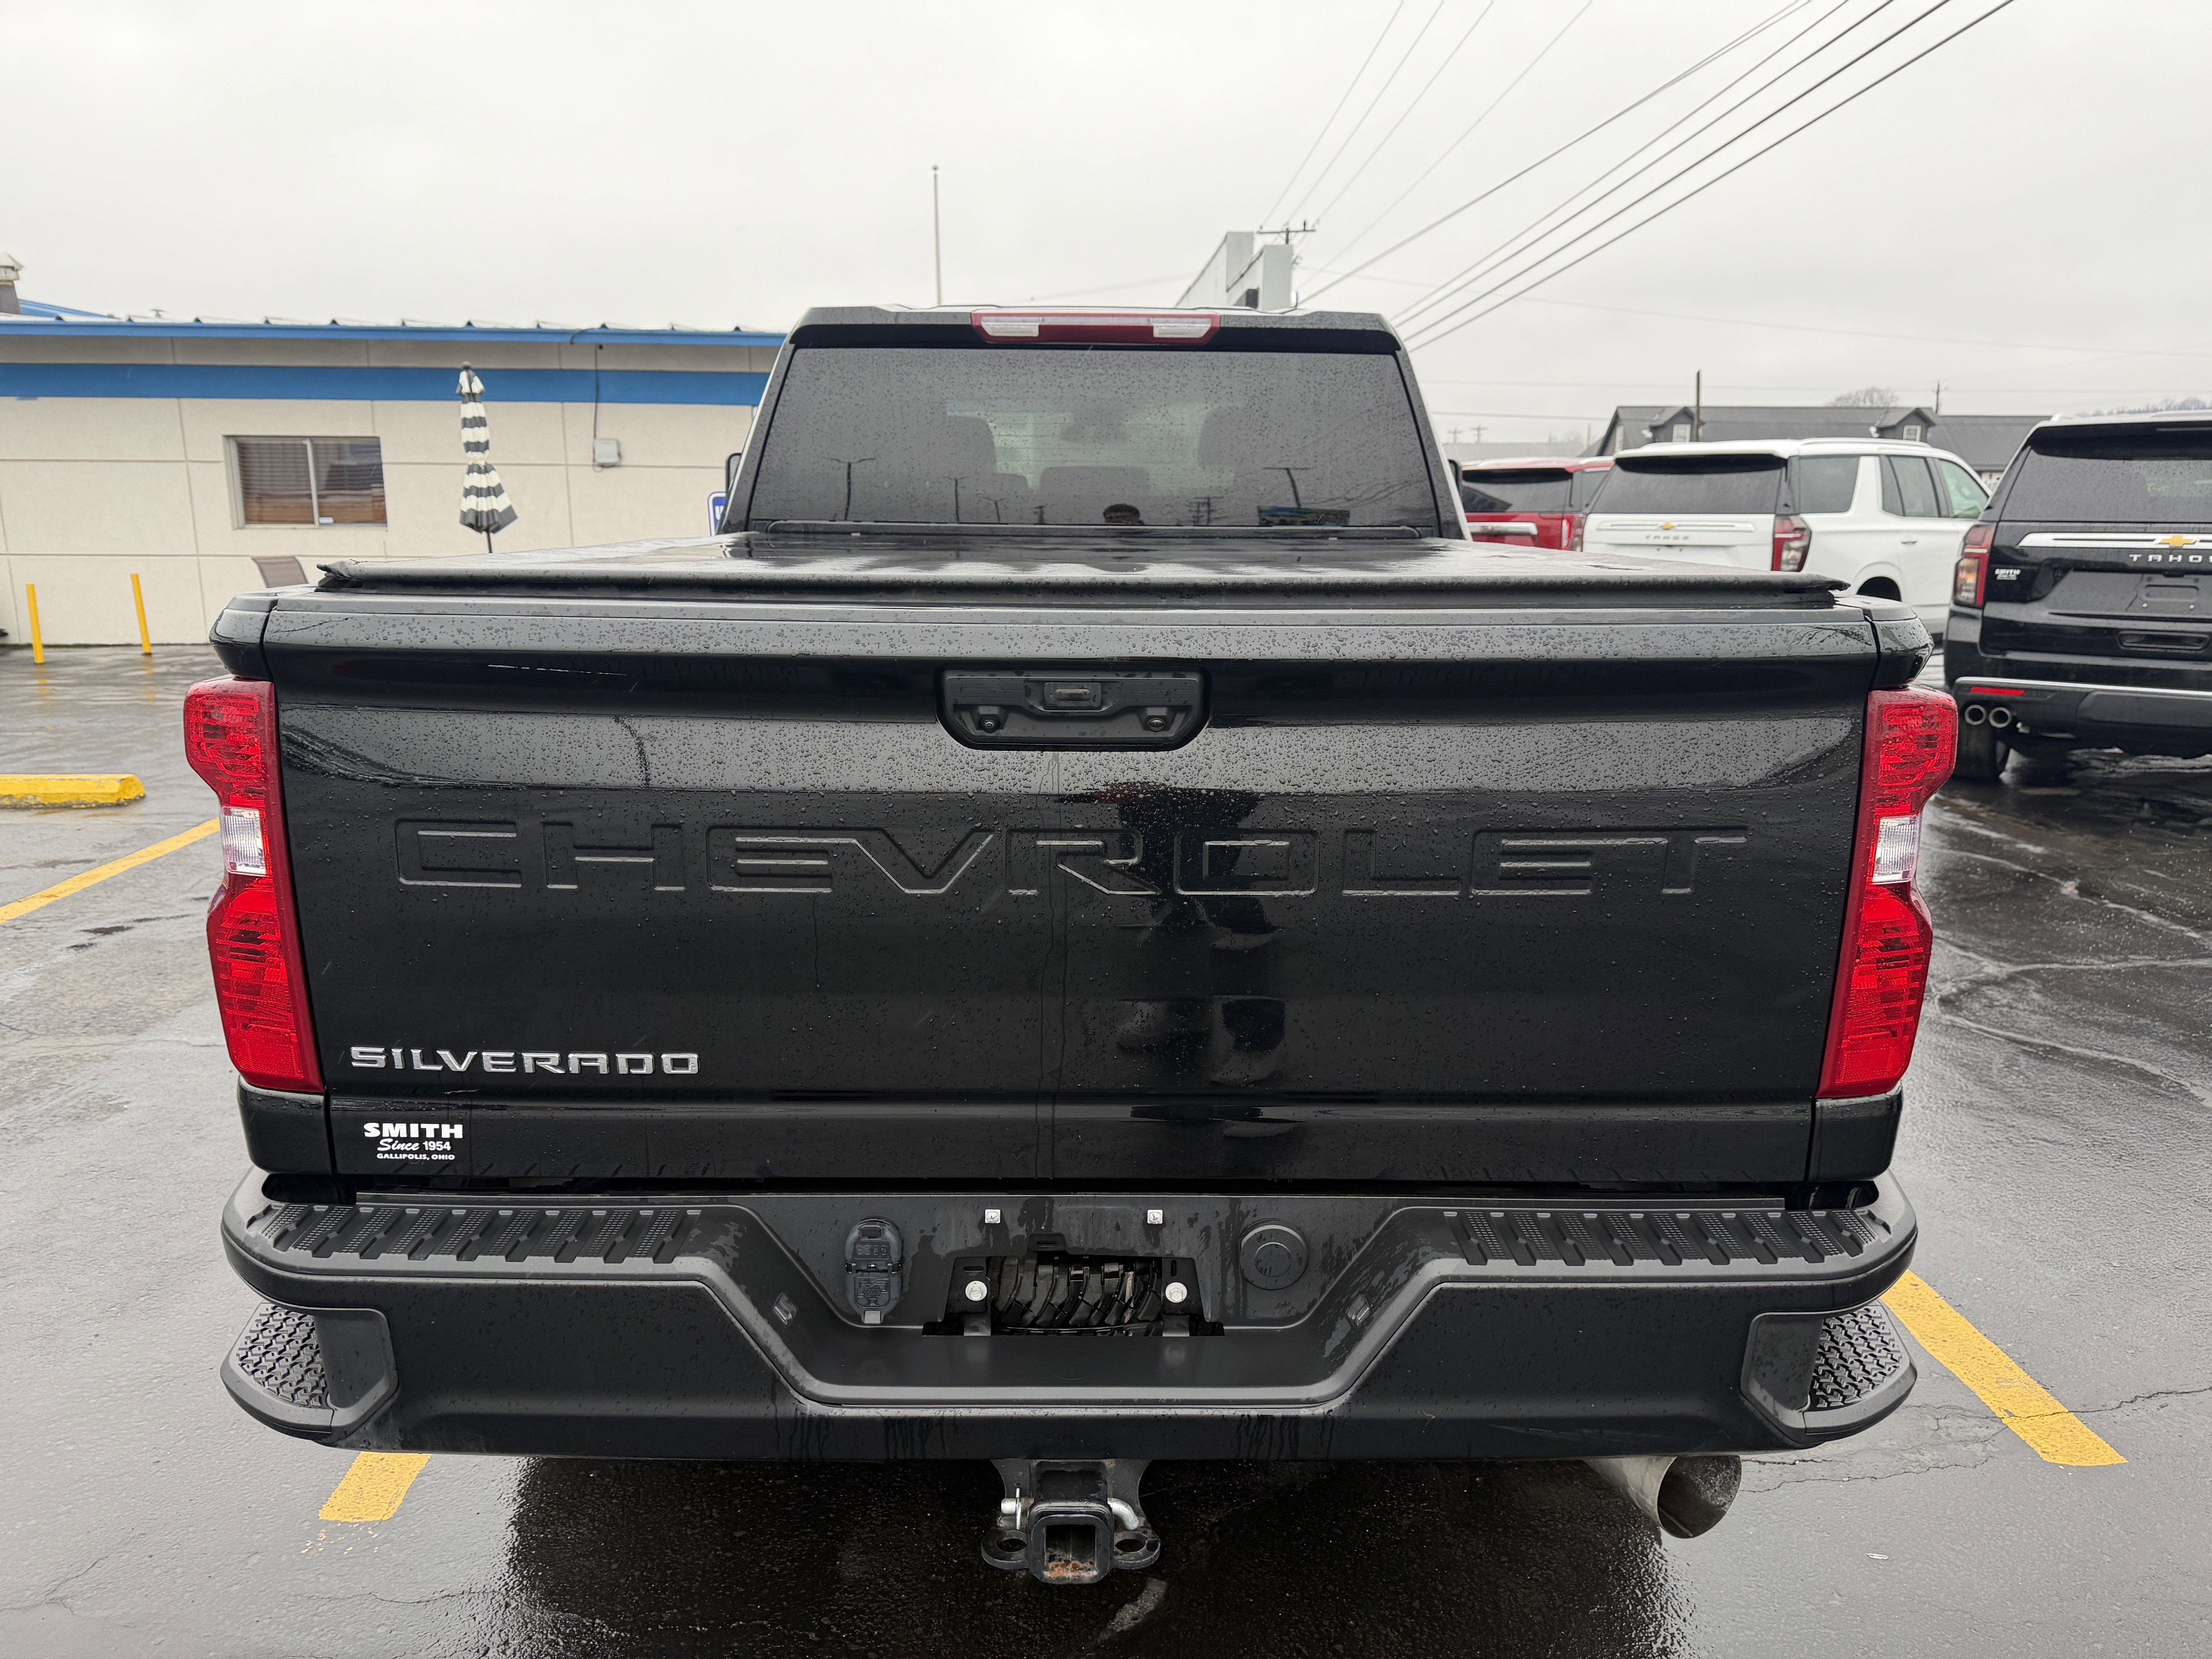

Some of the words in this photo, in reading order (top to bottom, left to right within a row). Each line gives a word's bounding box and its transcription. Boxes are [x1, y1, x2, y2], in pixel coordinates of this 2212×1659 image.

[394, 819, 1747, 896] CHEVROLET
[350, 1046, 700, 1075] SILVERADO
[364, 1123, 463, 1139] SMITH
[377, 1138, 420, 1151] Since
[423, 1141, 451, 1151] 1954
